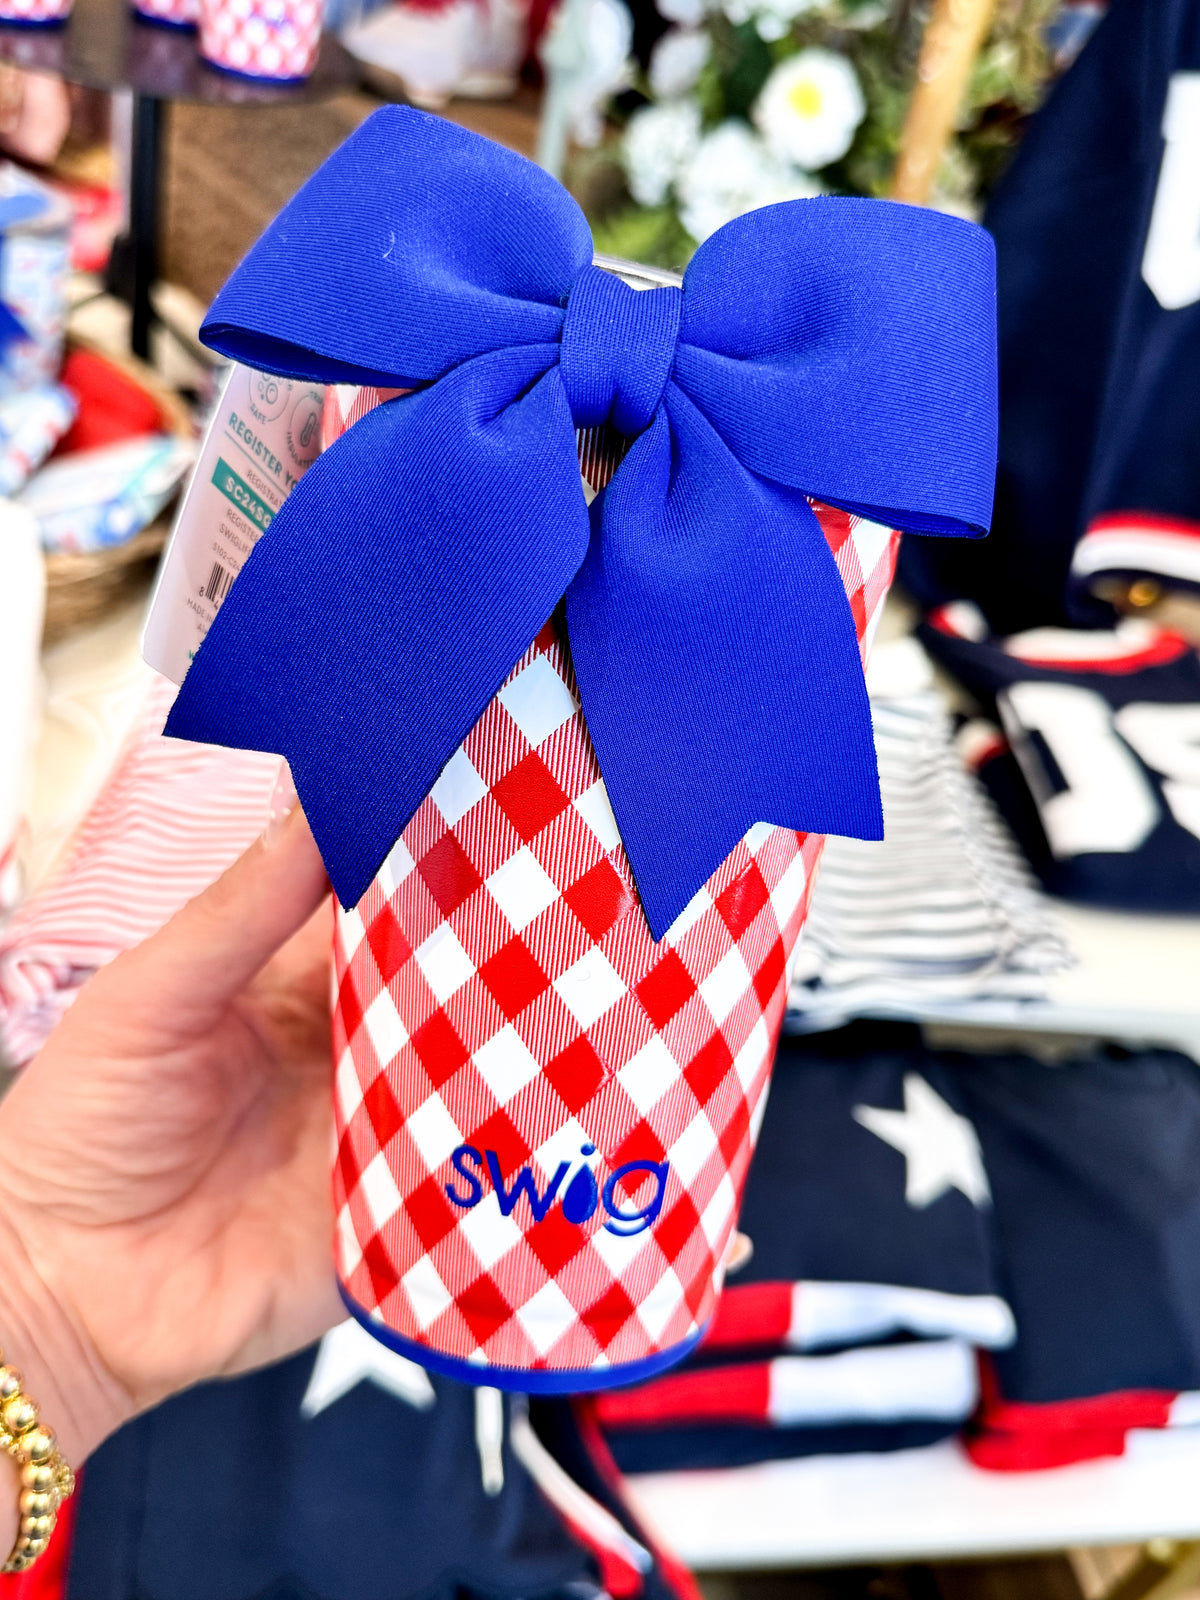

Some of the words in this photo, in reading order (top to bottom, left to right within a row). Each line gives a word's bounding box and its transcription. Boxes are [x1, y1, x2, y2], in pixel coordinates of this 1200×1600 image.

[249, 402, 266, 425] SAFE
[228, 411, 282, 477] REGISTER
[198, 585, 205, 597] 8
[444, 1142, 670, 1237] swig
